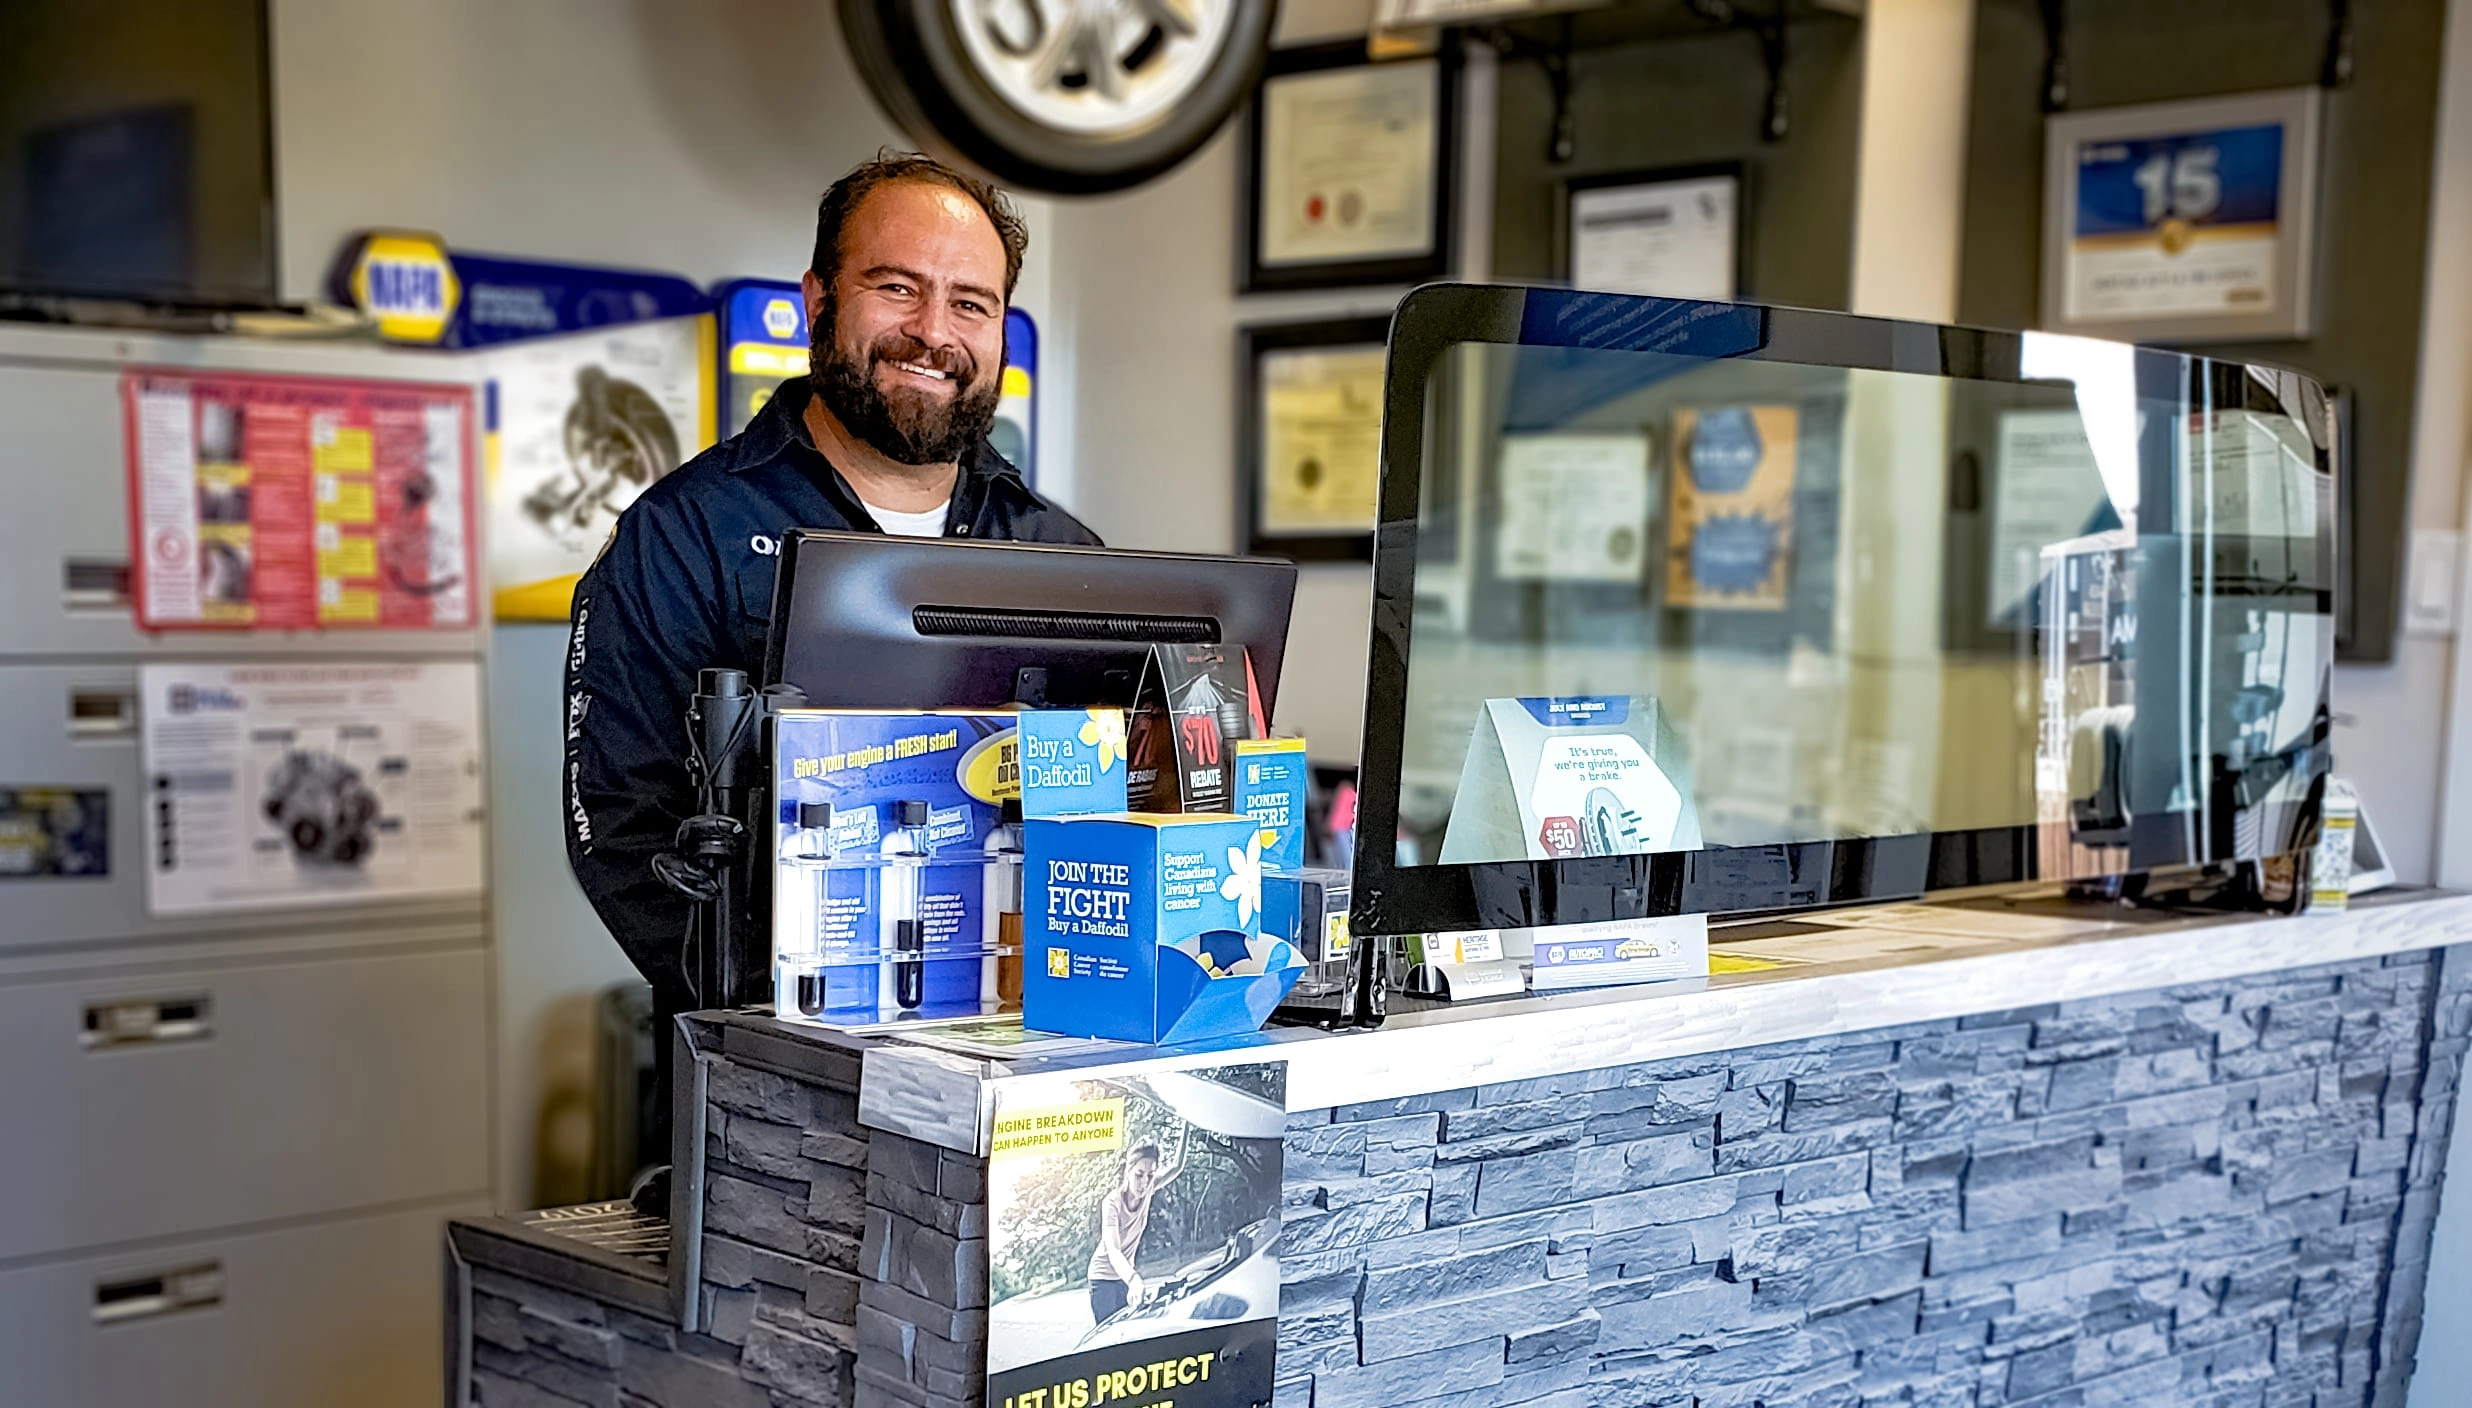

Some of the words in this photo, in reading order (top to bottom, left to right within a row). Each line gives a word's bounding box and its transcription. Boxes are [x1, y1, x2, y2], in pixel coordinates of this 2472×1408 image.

[2135, 147, 2221, 218] 15
[1026, 735, 1060, 763] Buy
[1063, 739, 1075, 757] a
[1182, 715, 1219, 765] $70
[794, 758, 819, 779] Give
[821, 753, 846, 777] your
[847, 745, 884, 769] engine
[886, 744, 894, 761] a
[894, 735, 928, 760] FRESH
[929, 728, 958, 753] start!
[1568, 747, 1589, 757] It's
[1591, 747, 1617, 757] true,
[1554, 760, 1585, 770] we're
[1587, 758, 1620, 771] giving
[1622, 758, 1640, 769] you
[1027, 763, 1092, 788] Daffodil
[1190, 768, 1222, 789] REBATE
[1579, 773, 1586, 781] a
[1588, 771, 1622, 781] brake.
[1246, 793, 1290, 808] DONATE
[1545, 828, 1576, 849] $50
[1164, 853, 1204, 867] Support
[1047, 860, 1087, 885] JOIN
[1090, 863, 1129, 886] THE
[1164, 866, 1217, 881] Canadians
[1164, 883, 1195, 897] living
[1196, 880, 1217, 894] with
[1047, 886, 1130, 920] FIGHT
[1164, 898, 1201, 911] cancer
[1048, 917, 1070, 935] Buy
[1072, 921, 1080, 933] a
[1081, 919, 1129, 937] Daffodil
[996, 1119, 1032, 1134] NGINE
[1036, 1110, 1114, 1129] BREAKDOWN
[993, 1139, 1011, 1151] CAN
[1013, 1134, 1052, 1148] HAPPEN
[1054, 1132, 1069, 1143] TO
[1072, 1127, 1114, 1141] ANYONE
[1053, 1379, 1090, 1408] US
[1094, 1353, 1215, 1404] PROTECT
